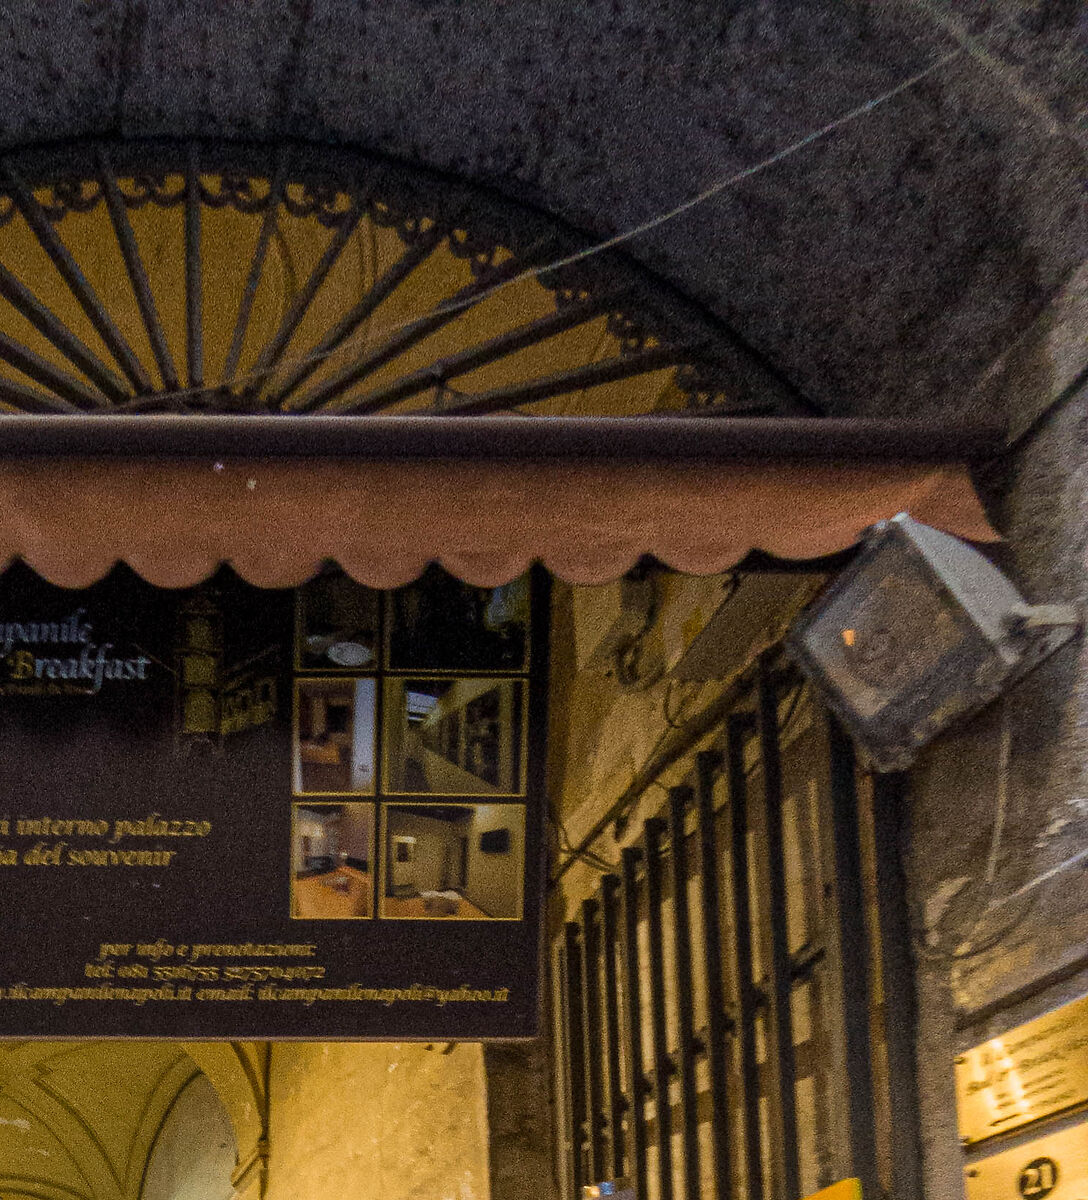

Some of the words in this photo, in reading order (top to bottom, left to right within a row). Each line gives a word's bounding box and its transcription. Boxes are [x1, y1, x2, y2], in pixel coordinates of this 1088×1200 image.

[6, 642, 151, 694] Breakfast
[15, 814, 109, 837] interno
[108, 811, 212, 844] palazzo
[22, 840, 68, 867] del
[67, 845, 177, 867] souvenir
[98, 943, 134, 962] per
[136, 938, 175, 962] info
[176, 945, 189, 957] e
[1023, 1163, 1055, 1195] 21
